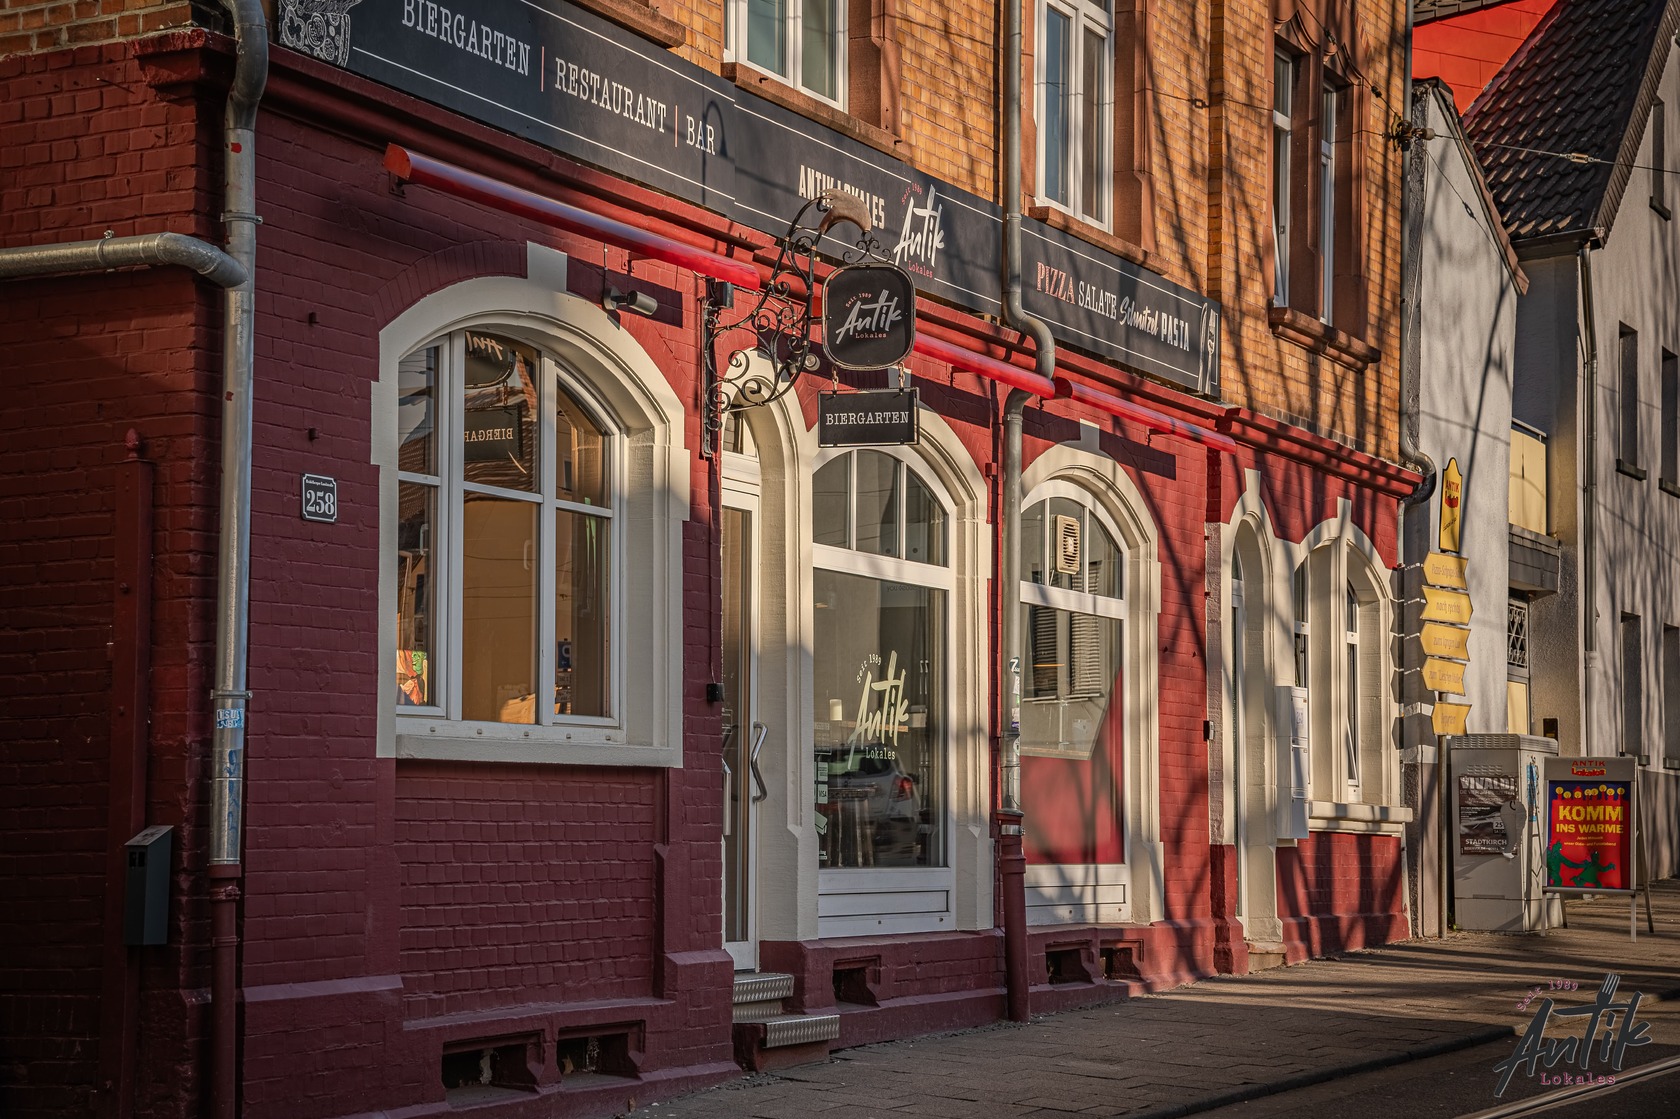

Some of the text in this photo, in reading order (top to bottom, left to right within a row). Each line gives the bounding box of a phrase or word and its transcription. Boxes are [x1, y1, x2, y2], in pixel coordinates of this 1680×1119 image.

[402, 0, 716, 155] BIERGARTEN RESTAURANT BAR
[908, 259, 933, 279] Lokales
[835, 289, 902, 344] Antik
[1036, 262, 1190, 351] PIZZA SALATE Schnitzel PASTA
[825, 411, 909, 425] BIERGARTEN
[306, 490, 335, 514] 258
[865, 746, 896, 760] Lokales
[1558, 805, 1624, 821] KOMM
[1556, 824, 1624, 834] INS WARME
